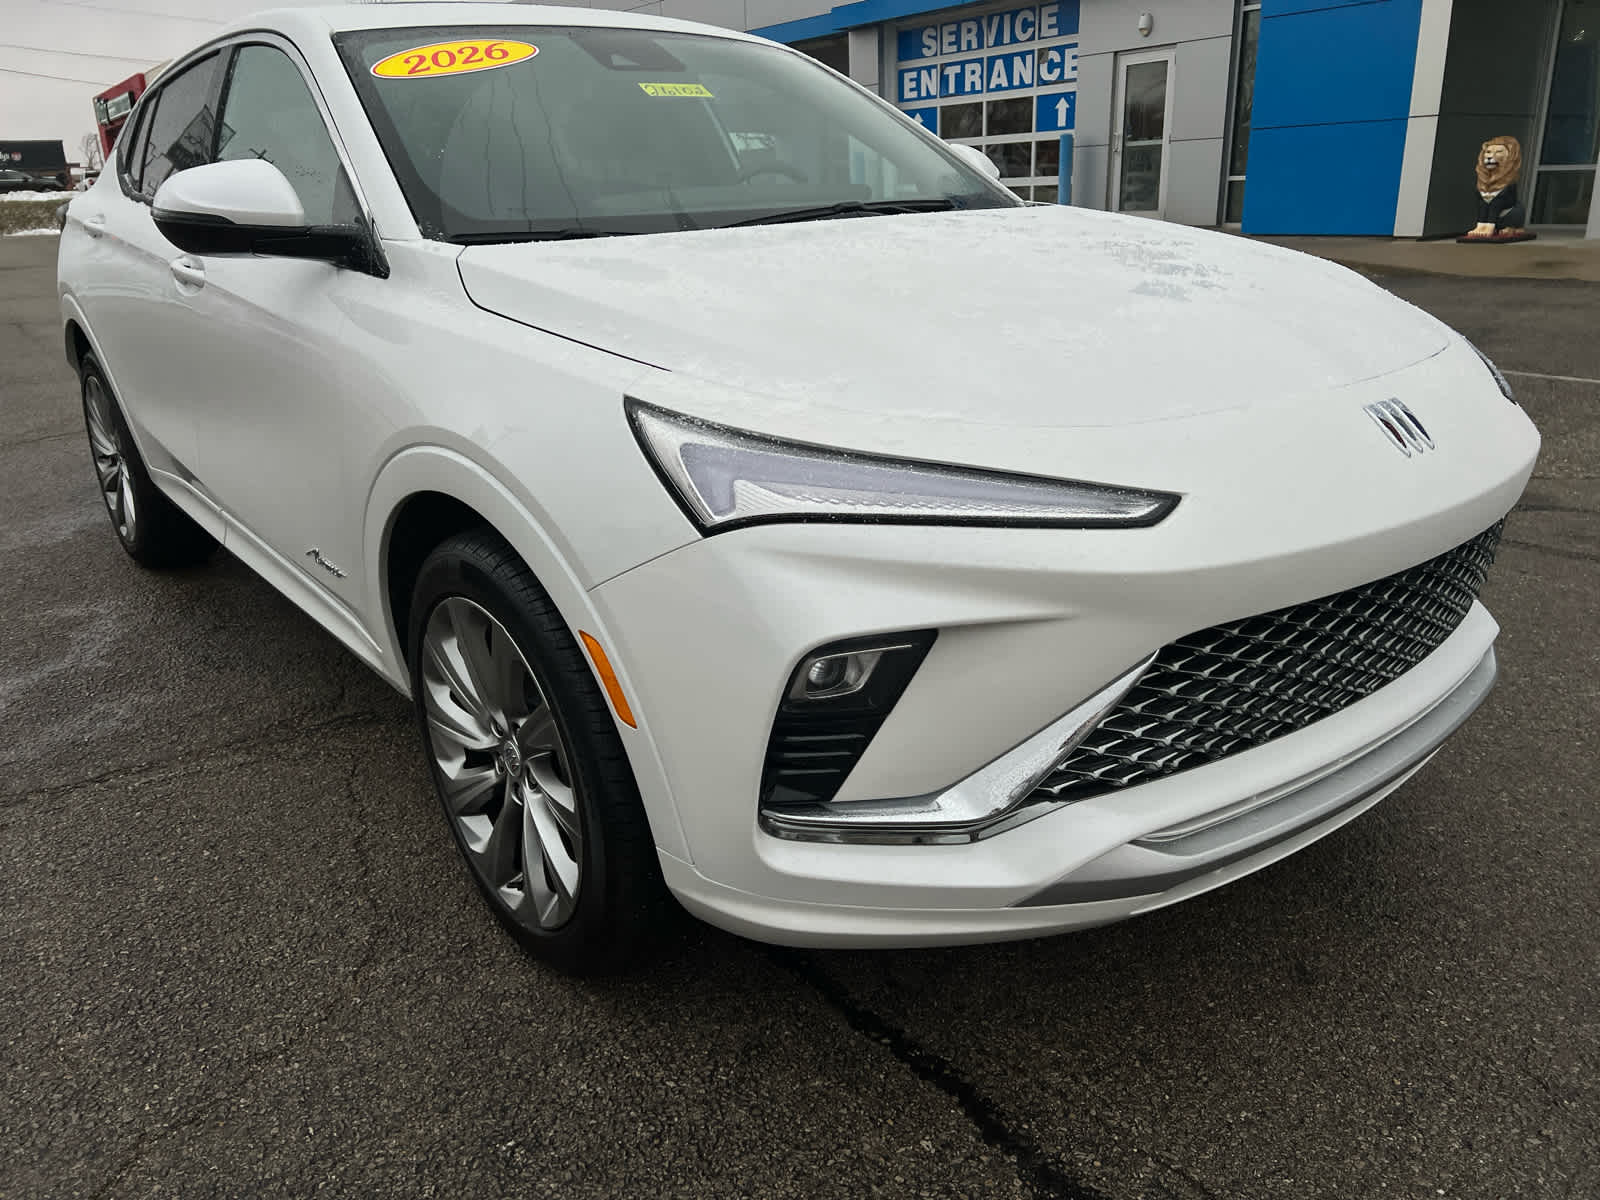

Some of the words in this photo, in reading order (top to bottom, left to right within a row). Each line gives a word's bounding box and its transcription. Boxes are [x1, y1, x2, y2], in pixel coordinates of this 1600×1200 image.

[922, 4, 1058, 57] SERVICE
[403, 42, 509, 75] 2026
[903, 48, 1078, 99] ENTRANCE
